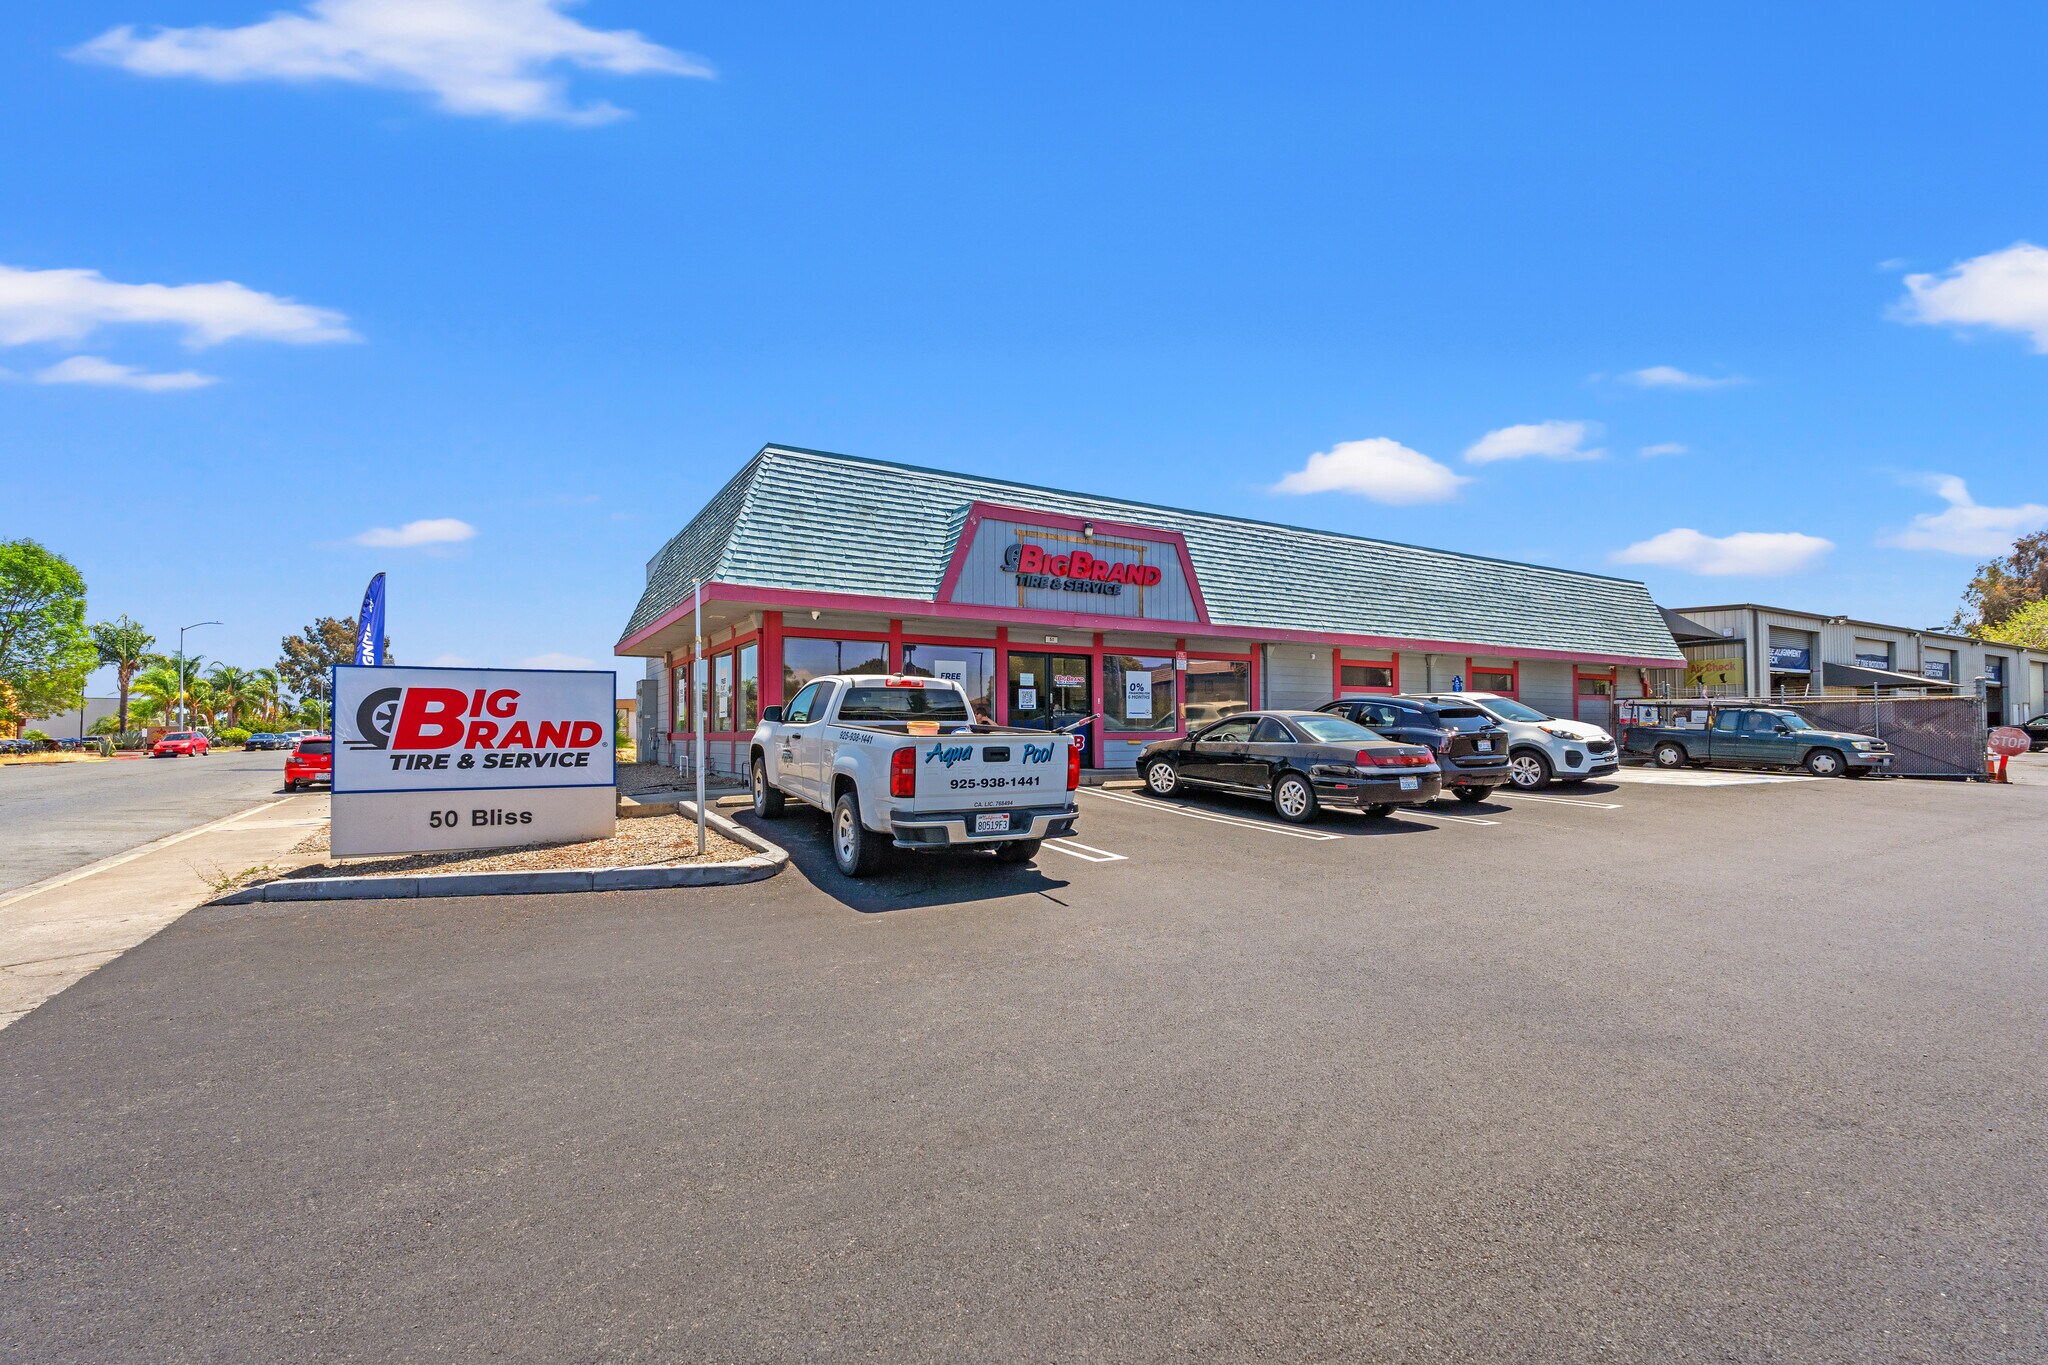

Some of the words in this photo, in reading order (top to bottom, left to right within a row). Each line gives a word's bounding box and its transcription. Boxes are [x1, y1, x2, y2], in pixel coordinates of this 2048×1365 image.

[1015, 574, 1049, 588] TIRE
[1050, 577, 1062, 590] &
[1063, 579, 1123, 595] SERVICE
[1774, 648, 1802, 658] ALIGNMENT
[1690, 664, 1705, 674] Air
[1706, 662, 1736, 672] Check
[940, 672, 962, 680] FREE
[1129, 682, 1145, 692] 0%
[1991, 735, 2027, 748] STOP
[389, 753, 450, 770] TIRE
[456, 753, 475, 769] &
[483, 752, 590, 768] SERVICE
[925, 742, 973, 768] Aqua
[1022, 742, 1055, 764] Pool
[950, 776, 1040, 789] 925-938-1441
[429, 810, 458, 828] 50
[472, 809, 533, 826] Bliss
